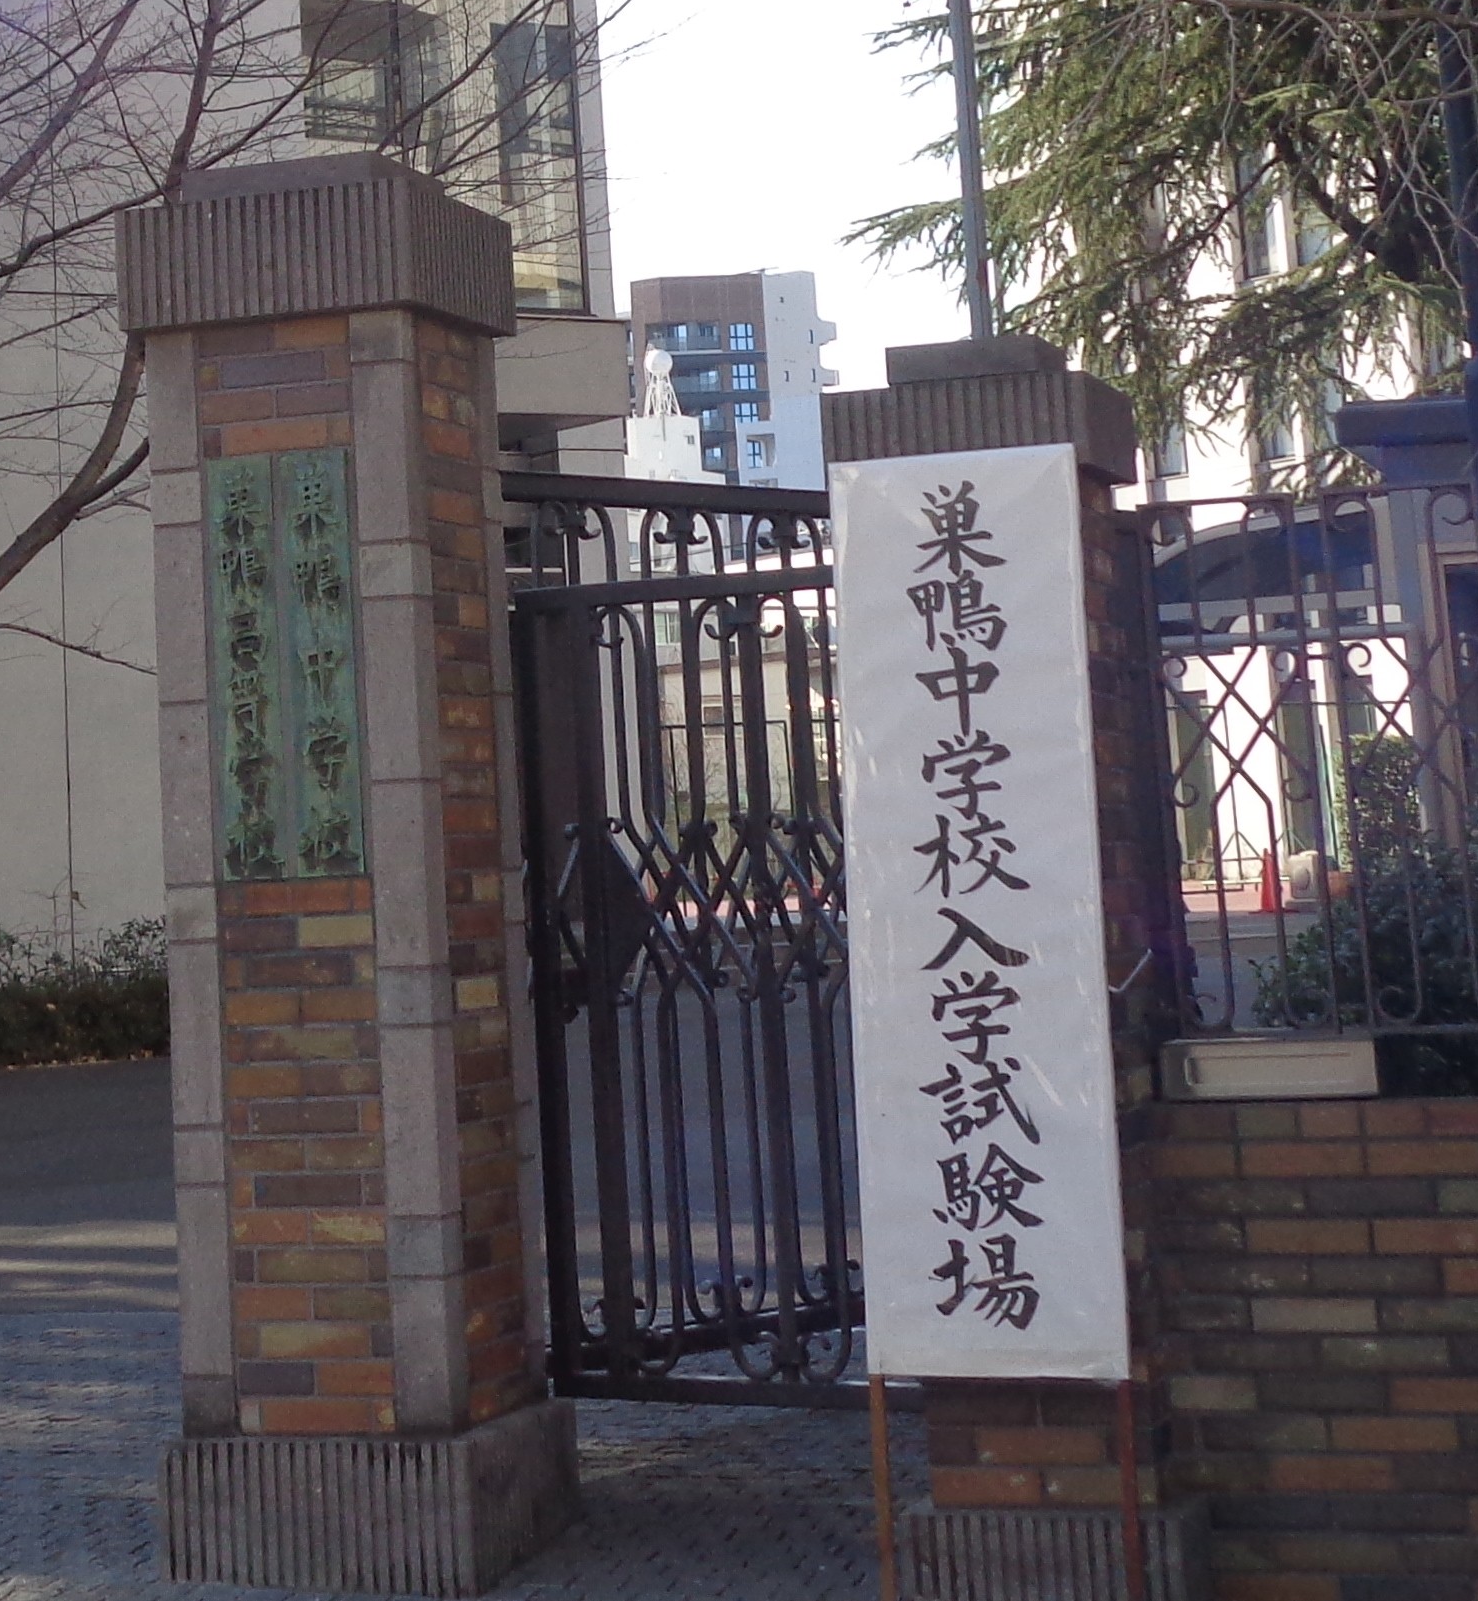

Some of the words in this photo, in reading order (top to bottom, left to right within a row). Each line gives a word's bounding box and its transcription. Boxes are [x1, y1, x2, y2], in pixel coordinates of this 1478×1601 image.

[907, 480, 1045, 1332] 巣鴨中学校入学試験場
